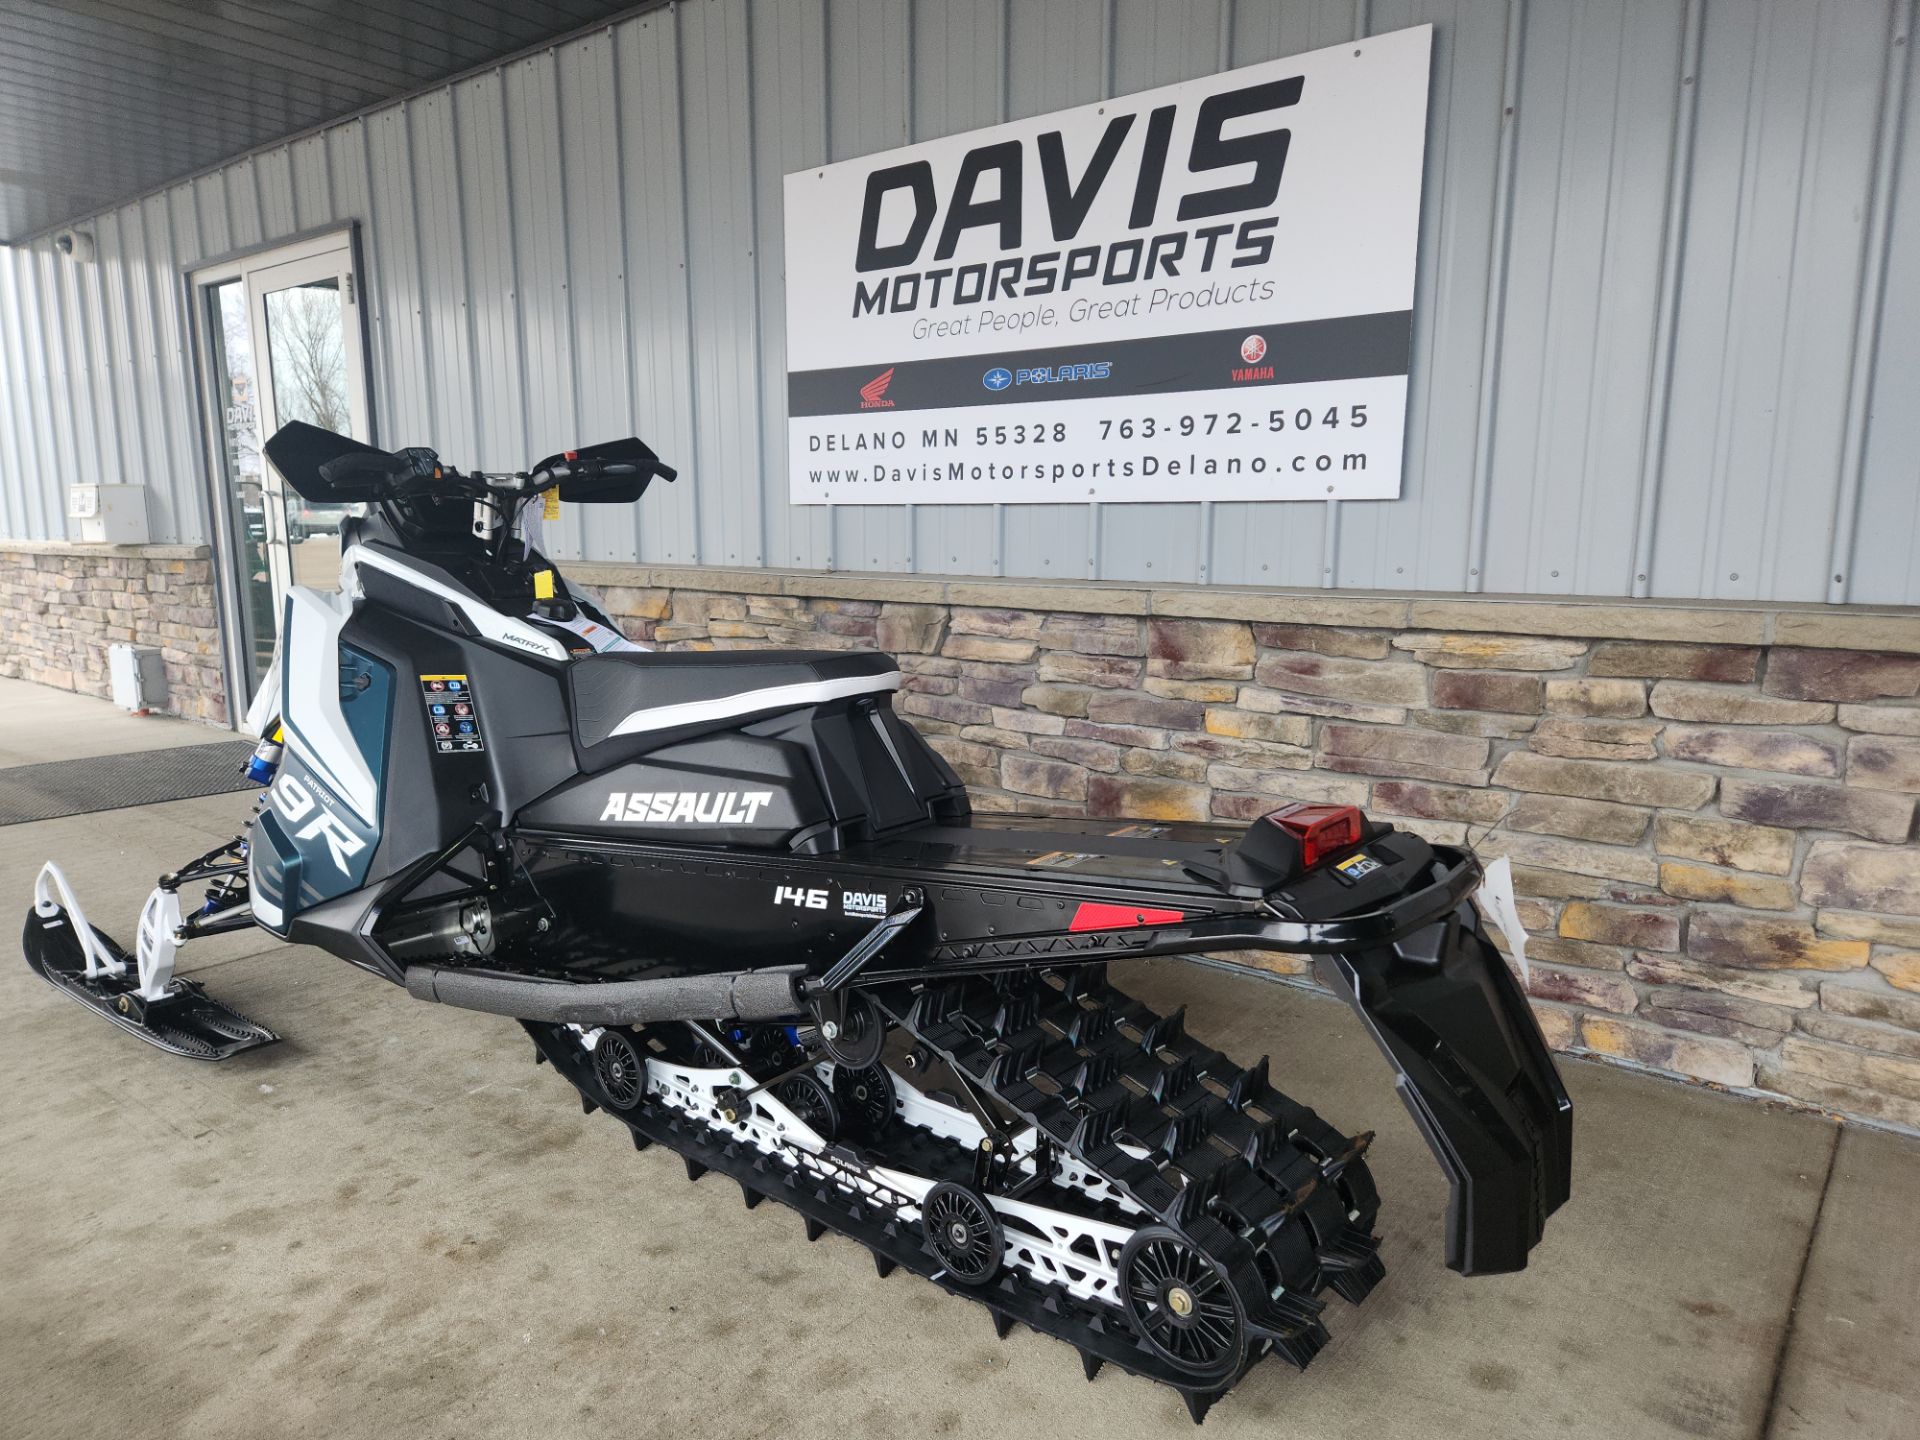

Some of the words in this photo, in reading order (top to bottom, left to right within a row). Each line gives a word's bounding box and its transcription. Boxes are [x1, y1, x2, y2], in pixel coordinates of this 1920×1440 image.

[855, 75, 1305, 273] DAVIS
[853, 217, 1279, 318] MOTORSPORTS
[912, 314, 972, 341] Great
[977, 303, 1060, 333] People,
[1069, 297, 1142, 323] Great
[1149, 278, 1276, 314] Products
[1232, 366, 1275, 382] YAMAHA
[861, 399, 896, 409] HONDA
[809, 431, 906, 452] DELANO
[922, 428, 959, 448] MN
[976, 422, 1067, 446] 55328
[1099, 404, 1368, 441] 763-972-5045
[809, 453, 1368, 484] www.DavisMotorsportsDelano.com
[502, 632, 551, 655] MATRYX
[303, 774, 336, 807] PATRIOT
[600, 791, 773, 824] ASSAULT
[270, 773, 367, 881] 9R
[774, 886, 829, 909] 146
[843, 891, 887, 908] DAVIS
